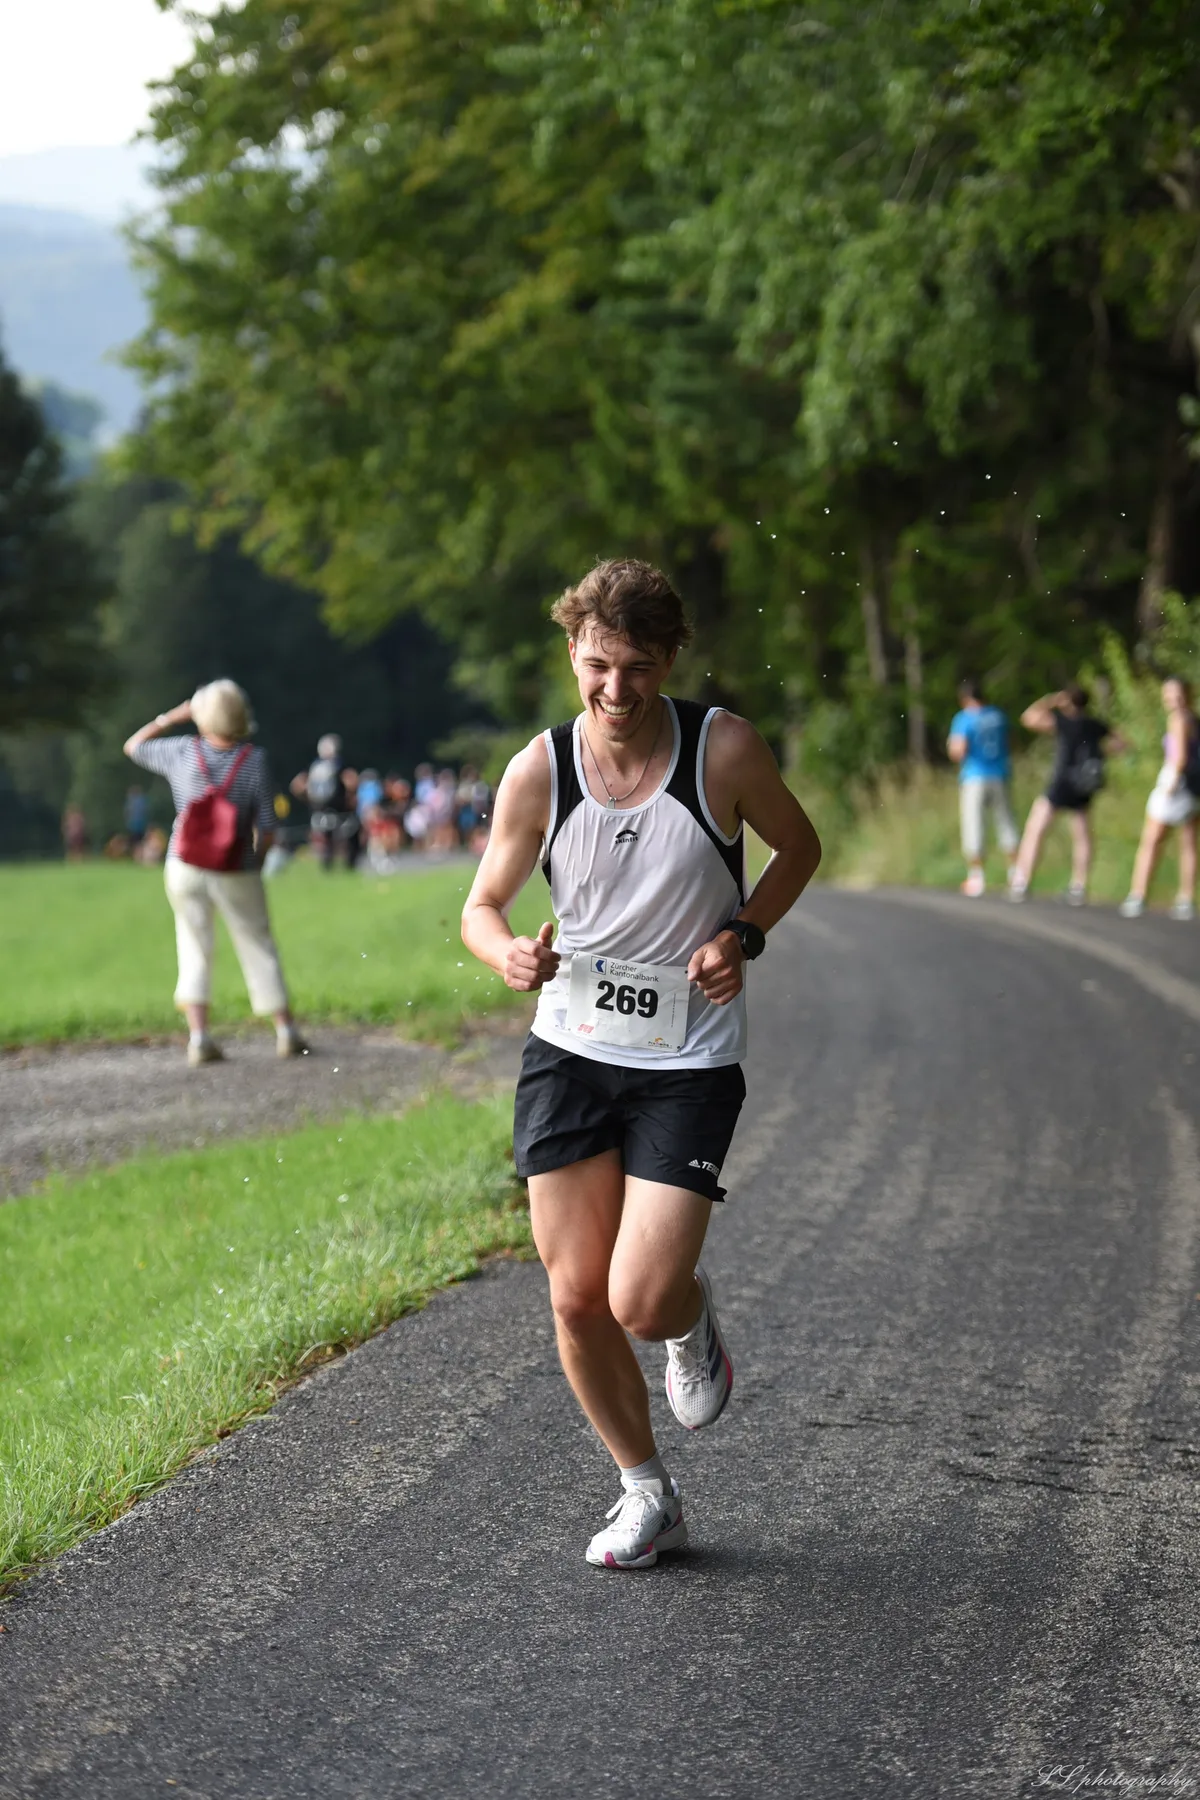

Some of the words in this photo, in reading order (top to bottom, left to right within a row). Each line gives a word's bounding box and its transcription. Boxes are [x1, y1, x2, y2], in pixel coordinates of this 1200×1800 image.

[610, 962, 637, 973] Zürcher
[609, 969, 659, 982] Kantonalbank
[595, 980, 658, 1018] 269
